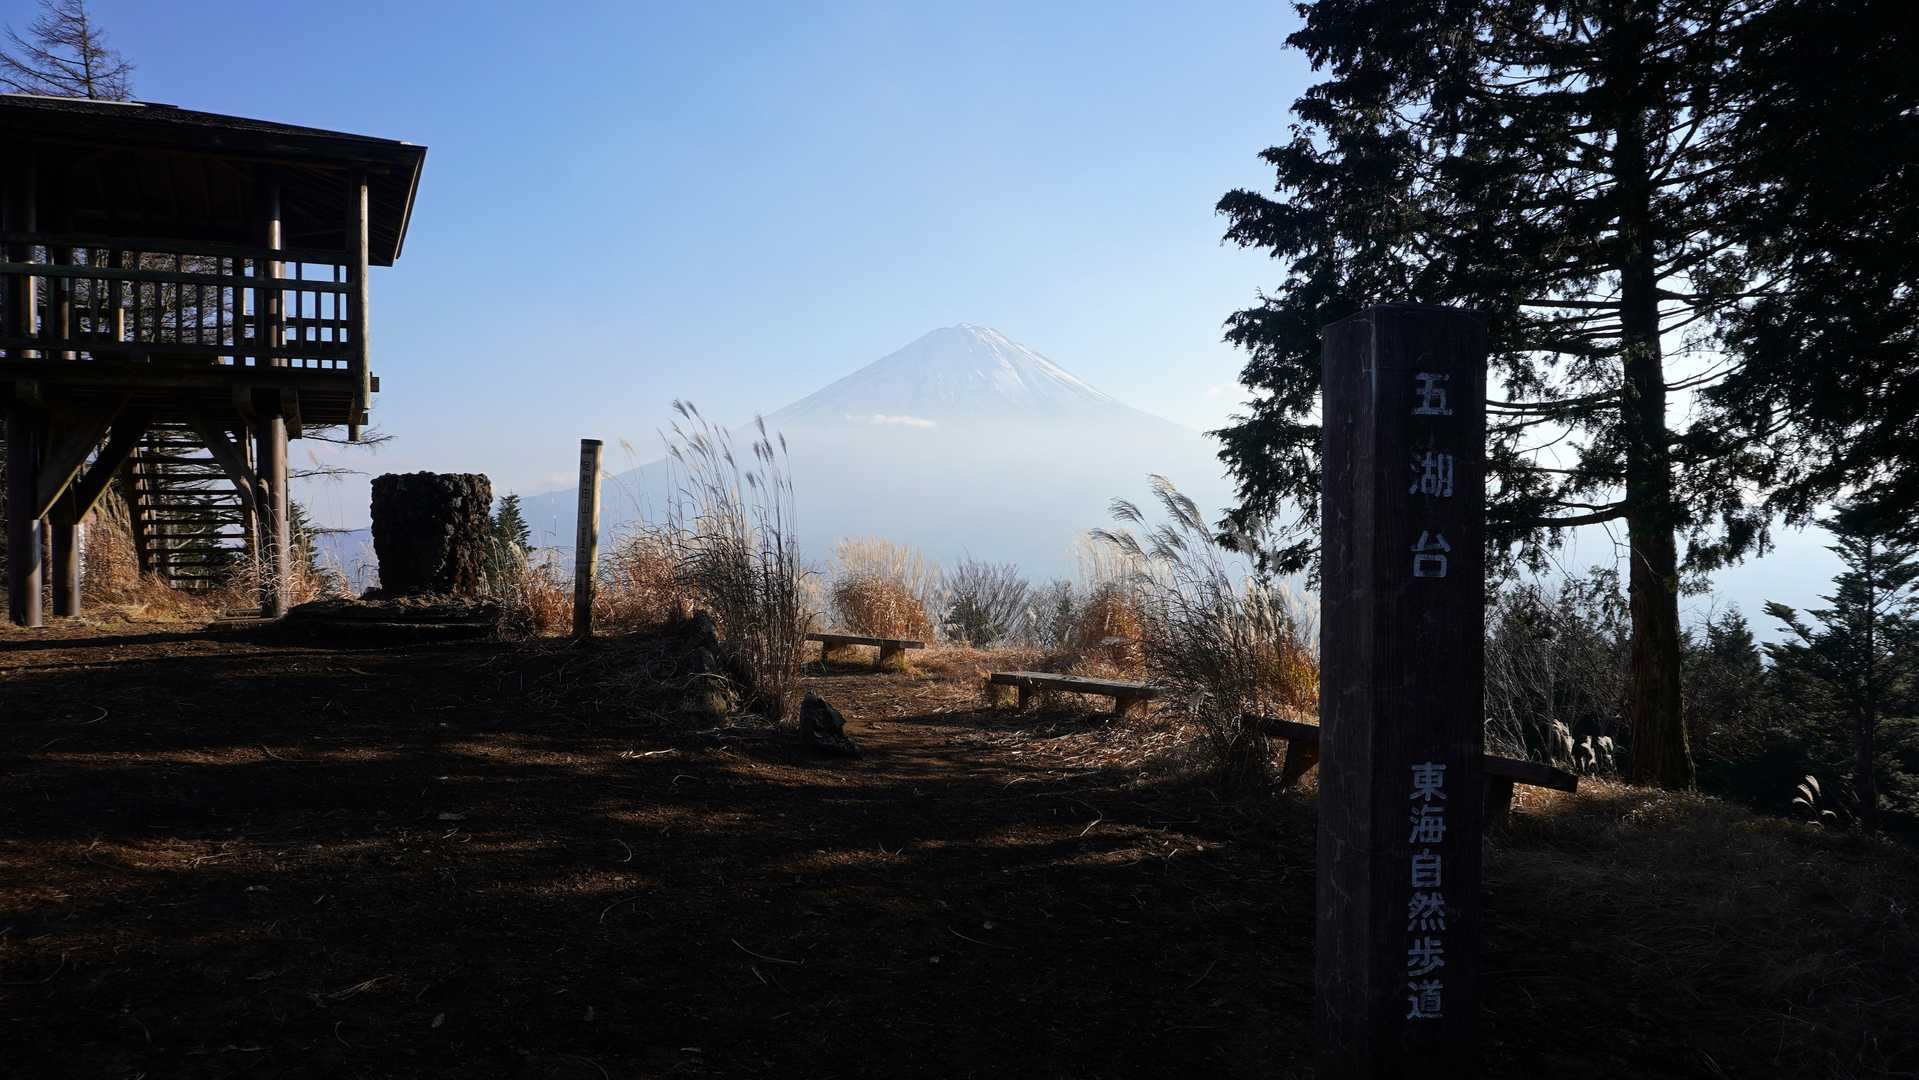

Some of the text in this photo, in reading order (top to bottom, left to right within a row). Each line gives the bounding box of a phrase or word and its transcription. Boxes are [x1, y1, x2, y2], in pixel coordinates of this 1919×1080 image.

[1408, 371, 1454, 578] 五湖台
[1407, 760, 1447, 1021] 東海自然歩道
